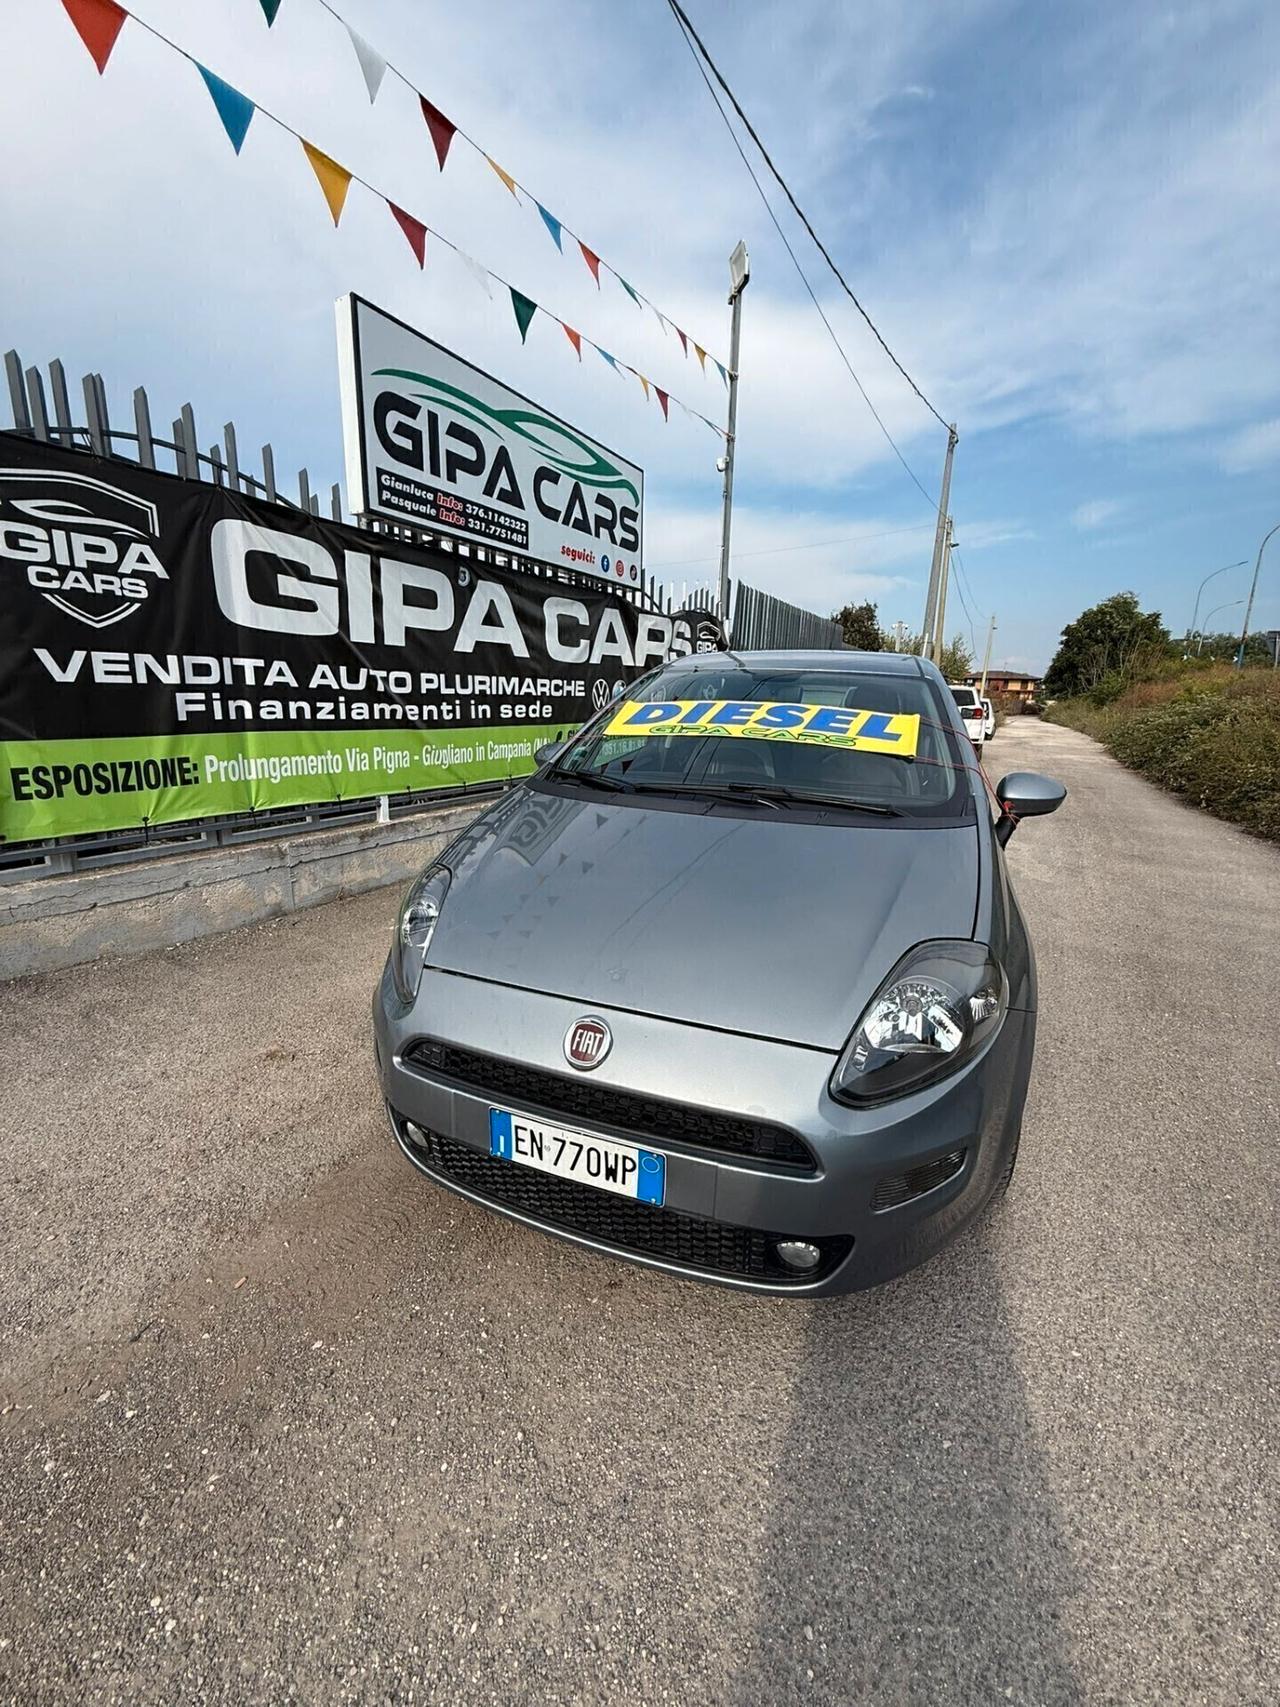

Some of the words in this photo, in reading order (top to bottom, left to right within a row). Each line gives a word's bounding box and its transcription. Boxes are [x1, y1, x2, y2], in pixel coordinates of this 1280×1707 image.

[373, 391, 526, 511] GIPA
[533, 466, 640, 553] CARS
[381, 474, 435, 501] Gianluca
[437, 493, 464, 512] Info:
[465, 504, 527, 532] 376.1142322
[382, 490, 437, 516] Pasquale
[439, 508, 466, 526] Info:
[468, 518, 527, 544] 331.7751481
[0, 520, 170, 580] GIPA
[561, 545, 596, 564] seguici:
[27, 566, 149, 600] CARS
[211, 518, 530, 658] GIPA
[543, 597, 693, 667] CARS
[33, 648, 299, 688] VENDITA
[308, 664, 412, 693] AUTO
[420, 673, 586, 698] PLURIMARCHE
[176, 692, 461, 721] Finanziamenti
[470, 701, 492, 720] in
[500, 700, 553, 719] sede
[624, 702, 903, 742] DIESEL
[649, 725, 732, 736] GIPA
[740, 727, 858, 747] CARS
[10, 755, 200, 801] ESPOSIZIONE:
[204, 749, 342, 784] Prolungamento
[345, 748, 370, 772] Via
[373, 746, 410, 774] Pigna
[422, 743, 474, 769] Giugliano
[475, 742, 486, 762] in
[487, 738, 532, 764] Campania
[572, 1029, 604, 1056] FIAT
